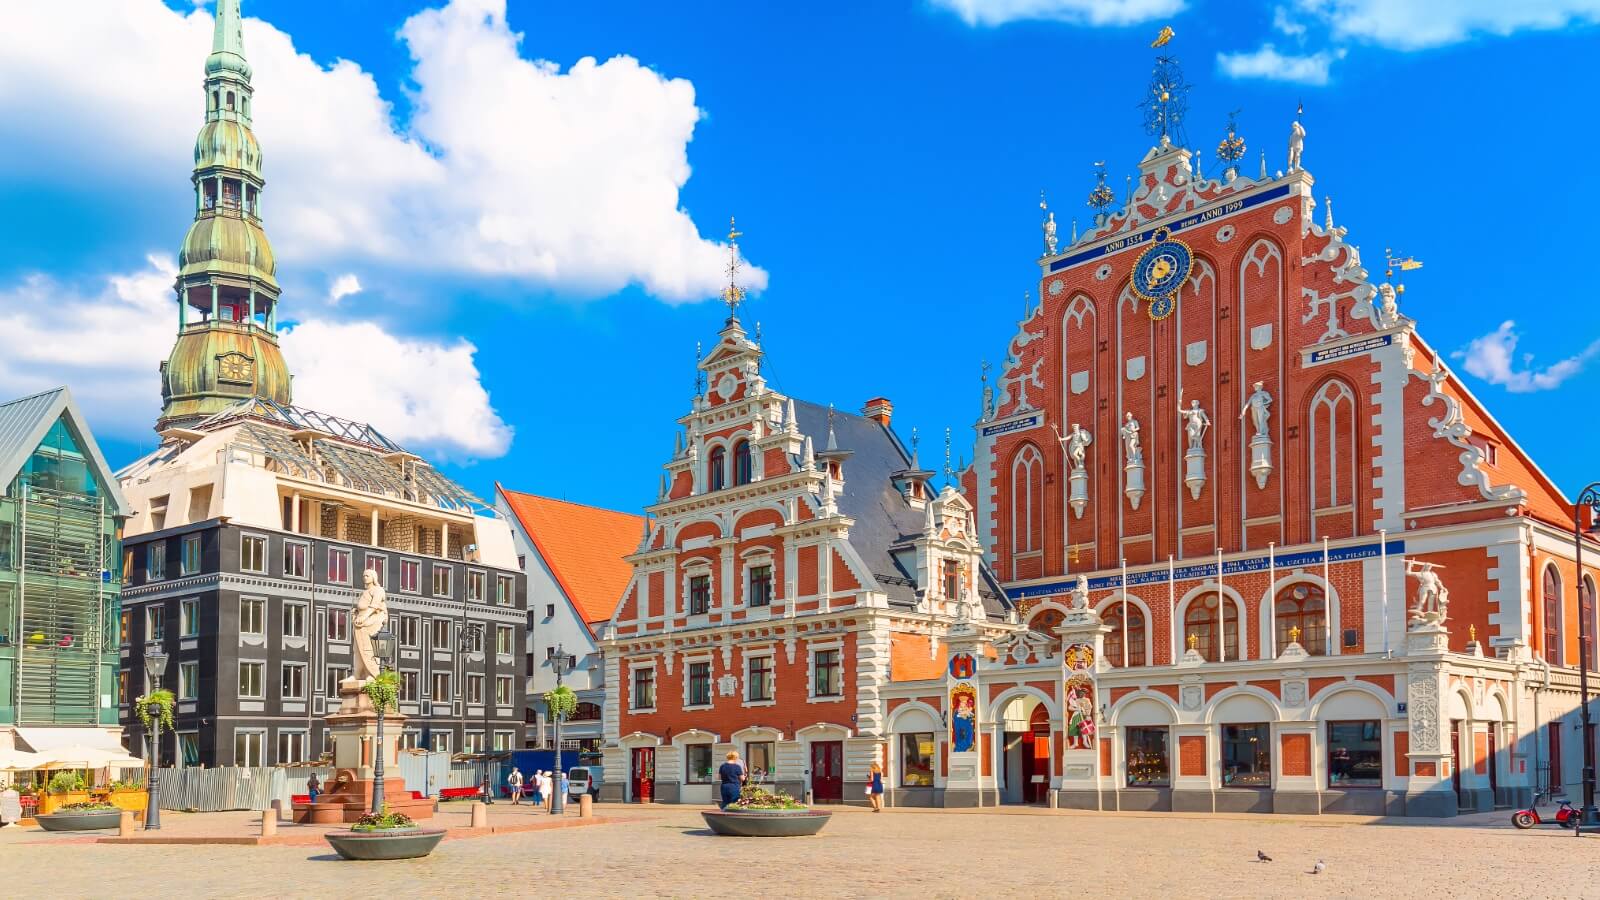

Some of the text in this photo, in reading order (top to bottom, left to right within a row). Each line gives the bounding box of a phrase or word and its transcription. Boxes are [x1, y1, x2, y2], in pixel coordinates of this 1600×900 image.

[1201, 207, 1222, 222] ANNO
[1225, 200, 1243, 213] 1999
[1105, 240, 1124, 254] ANNO
[1190, 564, 1219, 572] SAGRAUT
[1209, 566, 1244, 575] PAATIEM
[1319, 553, 1343, 562] RGAS
